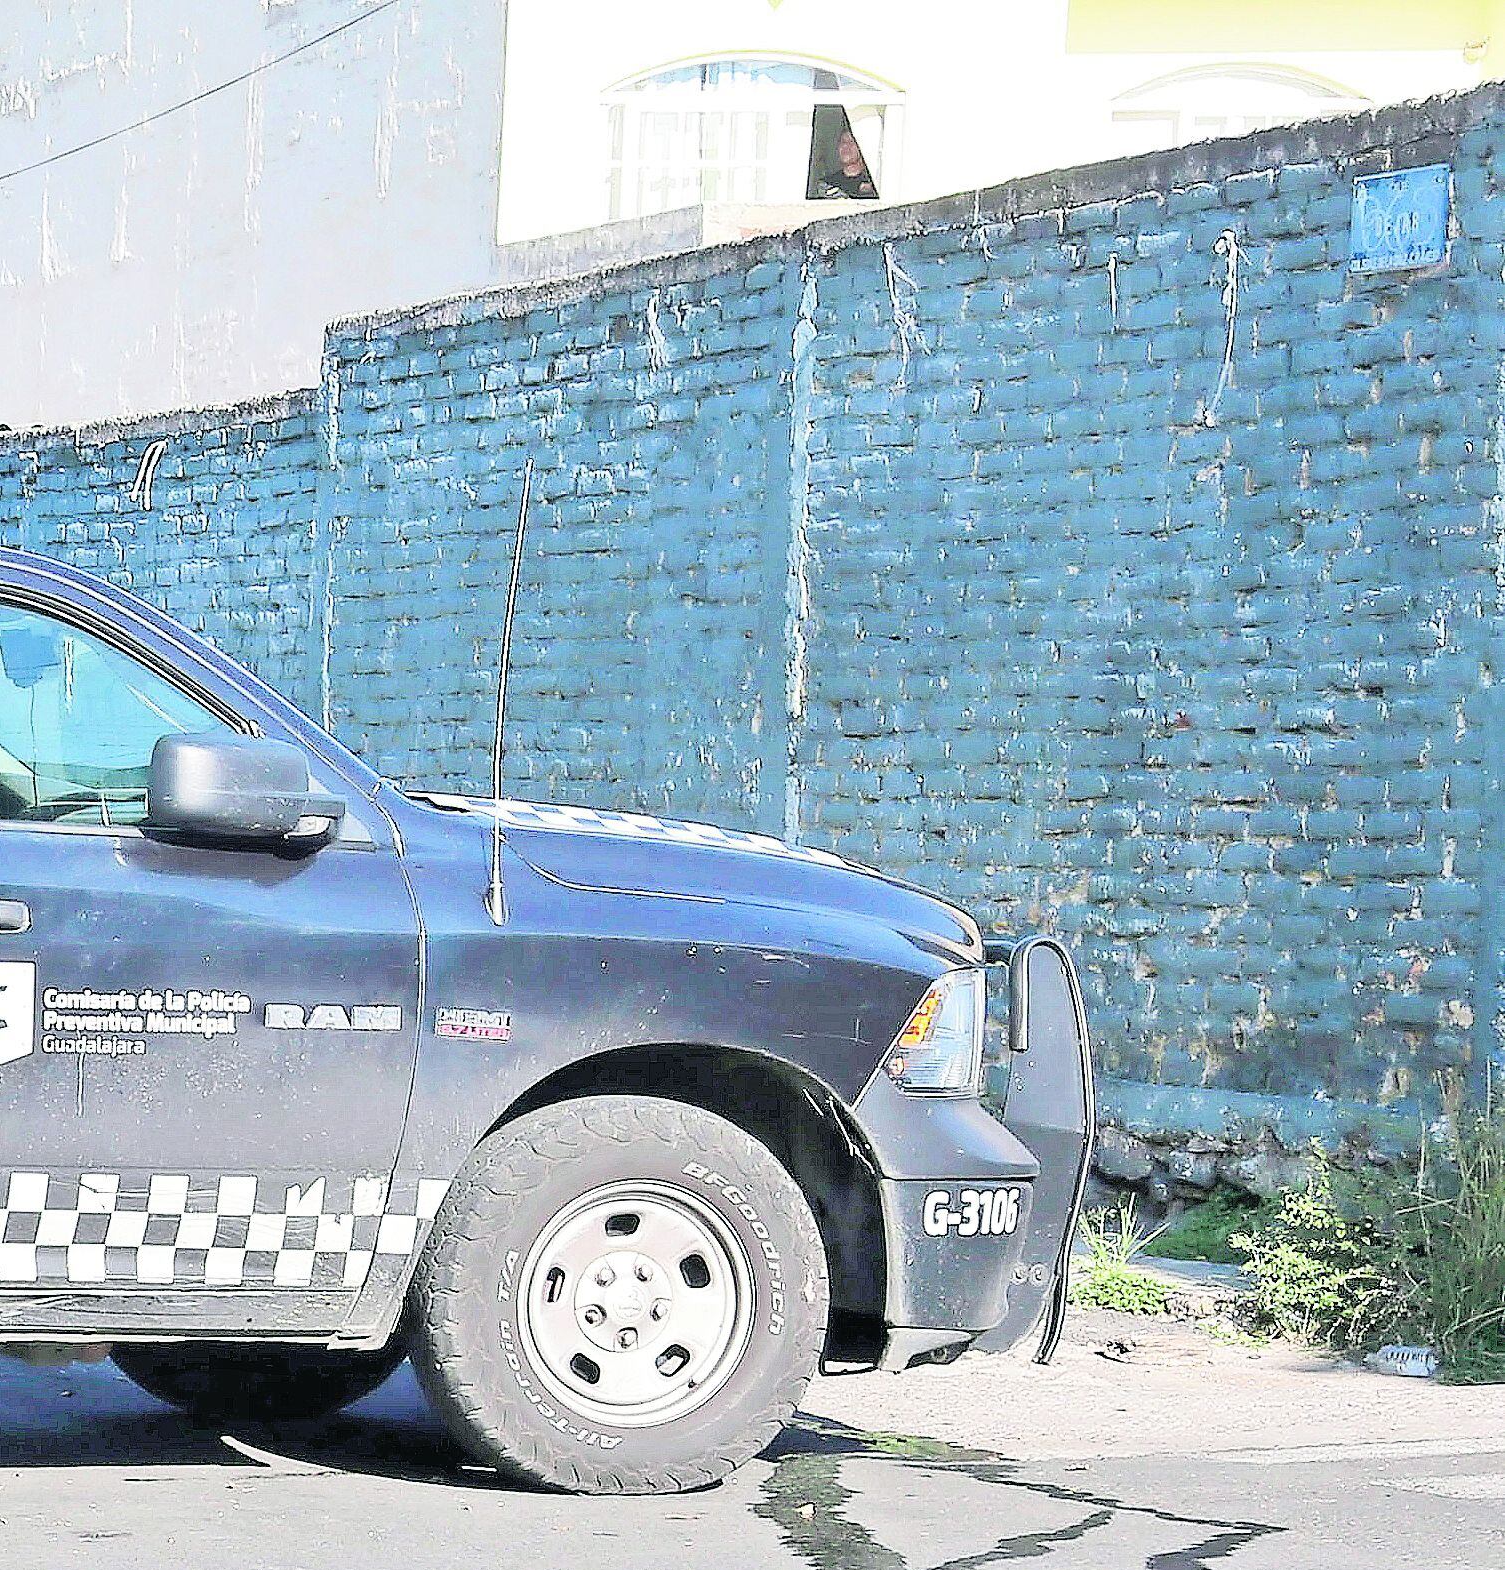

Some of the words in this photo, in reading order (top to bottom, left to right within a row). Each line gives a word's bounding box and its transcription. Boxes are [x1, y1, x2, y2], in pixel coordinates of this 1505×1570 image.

[138, 989, 164, 1011] de
[165, 989, 185, 1012] la
[42, 1010, 144, 1033] Preventiva
[146, 1012, 237, 1039] Municipal
[264, 1003, 402, 1031] RAM
[42, 1034, 146, 1058] Guadalajara
[923, 1187, 1021, 1237] G-3106
[681, 1162, 786, 1336] BFGoodrich
[497, 1250, 520, 1303] T/A
